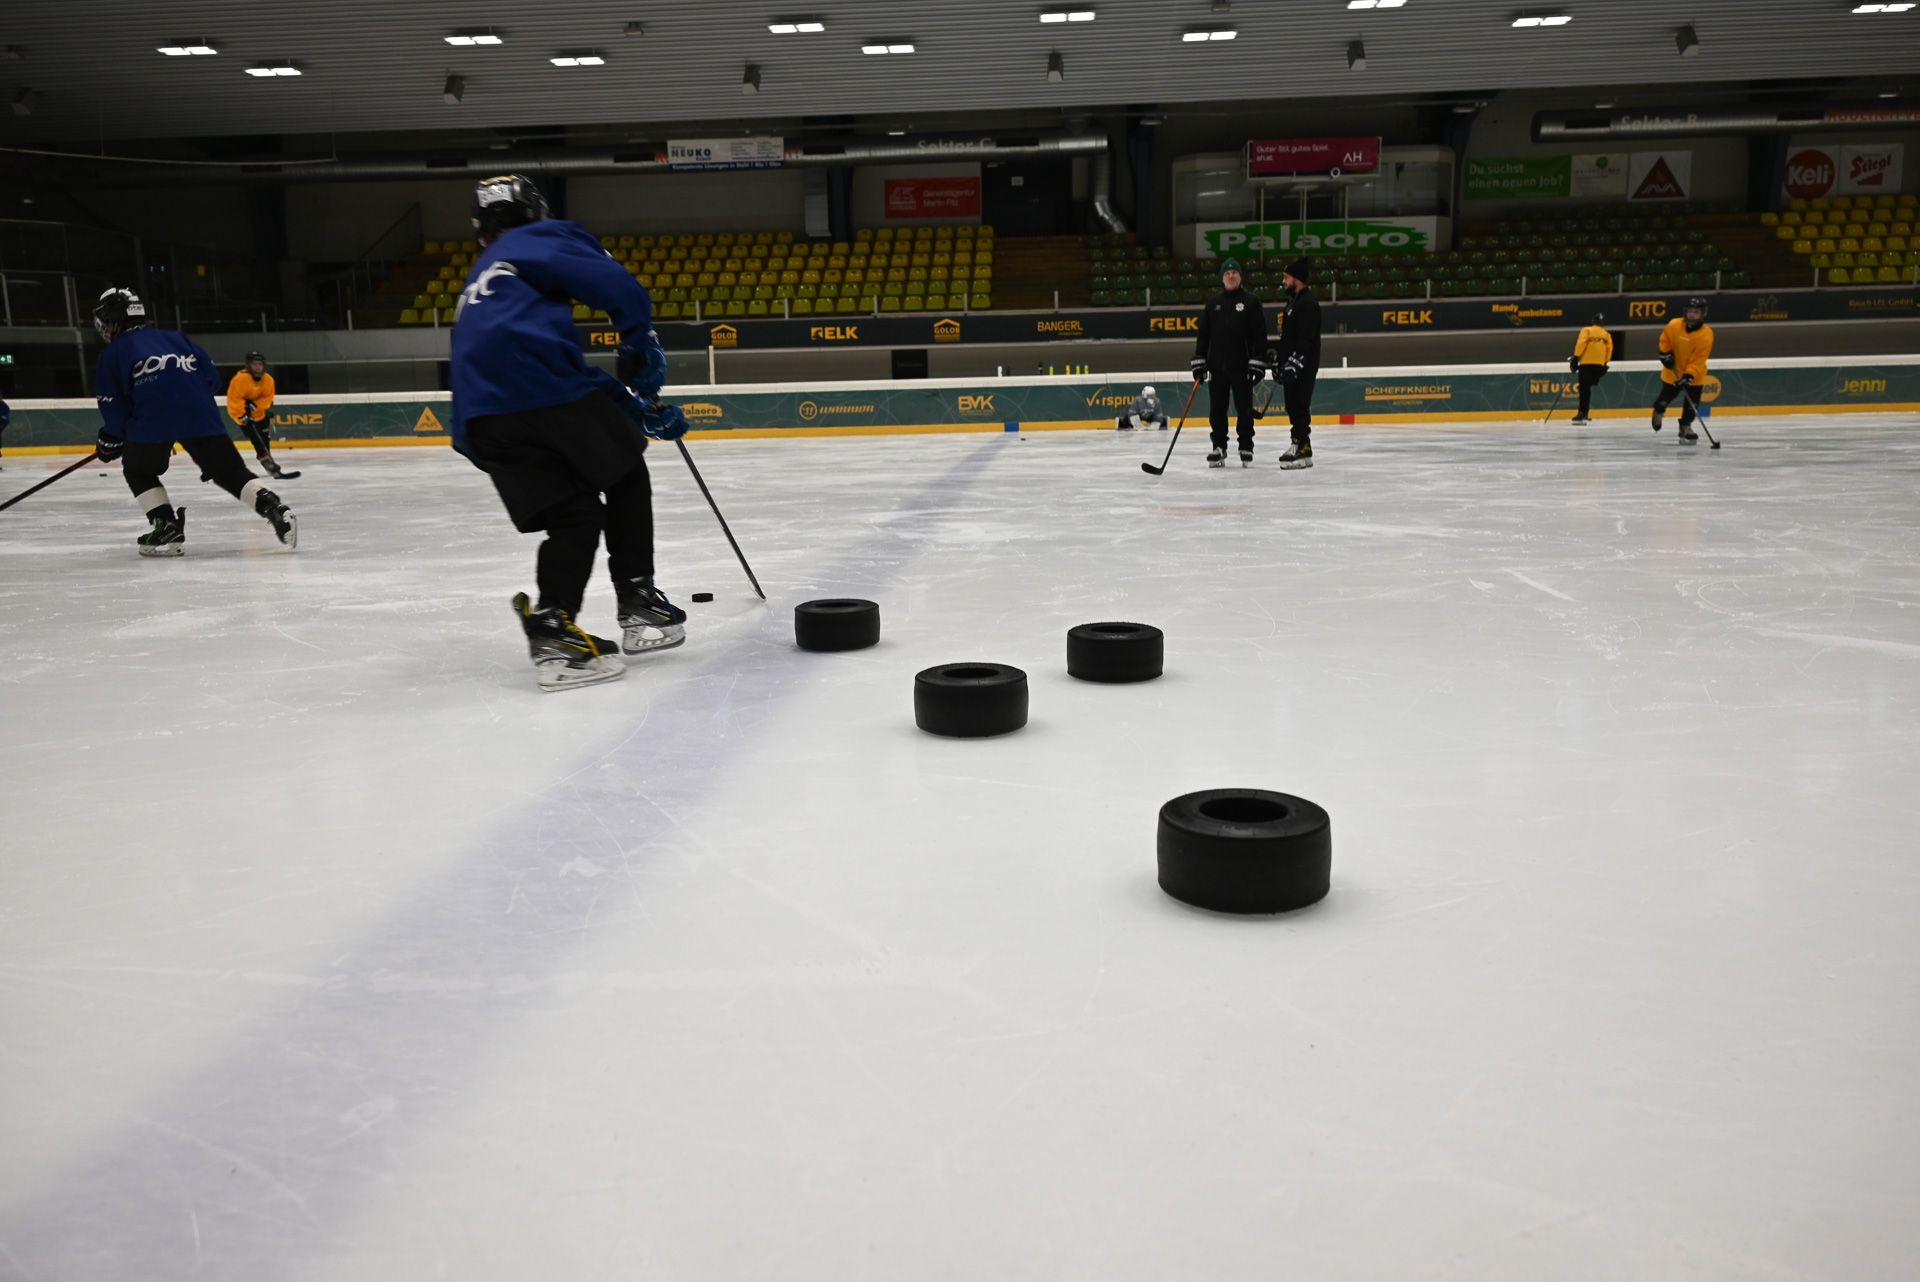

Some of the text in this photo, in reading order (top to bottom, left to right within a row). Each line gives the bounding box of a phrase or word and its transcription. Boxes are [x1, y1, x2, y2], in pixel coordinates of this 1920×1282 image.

[671, 148, 711, 157] NEUKO
[1850, 154, 1892, 178] Stiegl
[1788, 164, 1829, 186] Keli
[1219, 224, 1410, 251] Palaoro
[1397, 309, 1433, 325] ELK
[1629, 301, 1667, 318] RTC
[1037, 319, 1084, 332] BANGERL
[1164, 316, 1199, 331] ELK
[824, 326, 859, 340] ELK
[1364, 384, 1451, 395] SCHEFFKNECHT
[958, 395, 993, 411] BVK
[271, 414, 323, 425] UNZ
